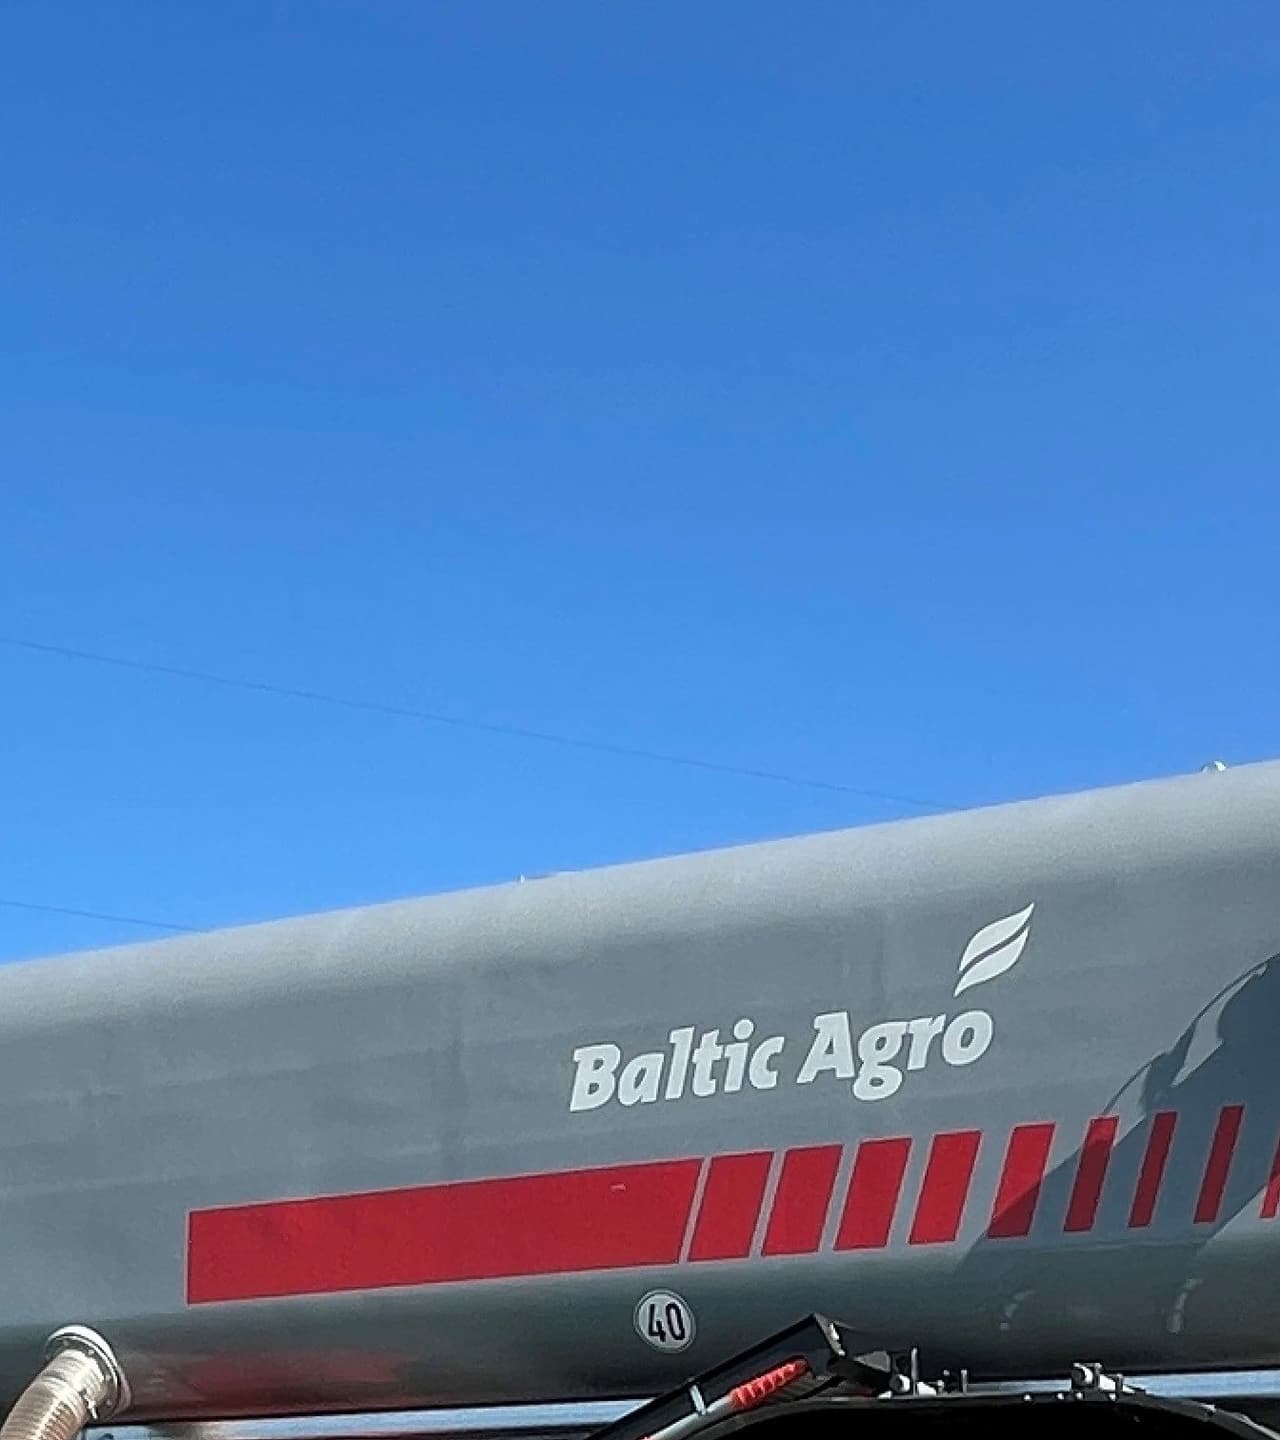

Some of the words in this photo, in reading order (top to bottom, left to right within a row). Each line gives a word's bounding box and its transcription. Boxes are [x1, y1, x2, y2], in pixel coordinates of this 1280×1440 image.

[570, 1018, 785, 1113] Baltic
[796, 1008, 994, 1101] Agro
[648, 1302, 686, 1342] 40
